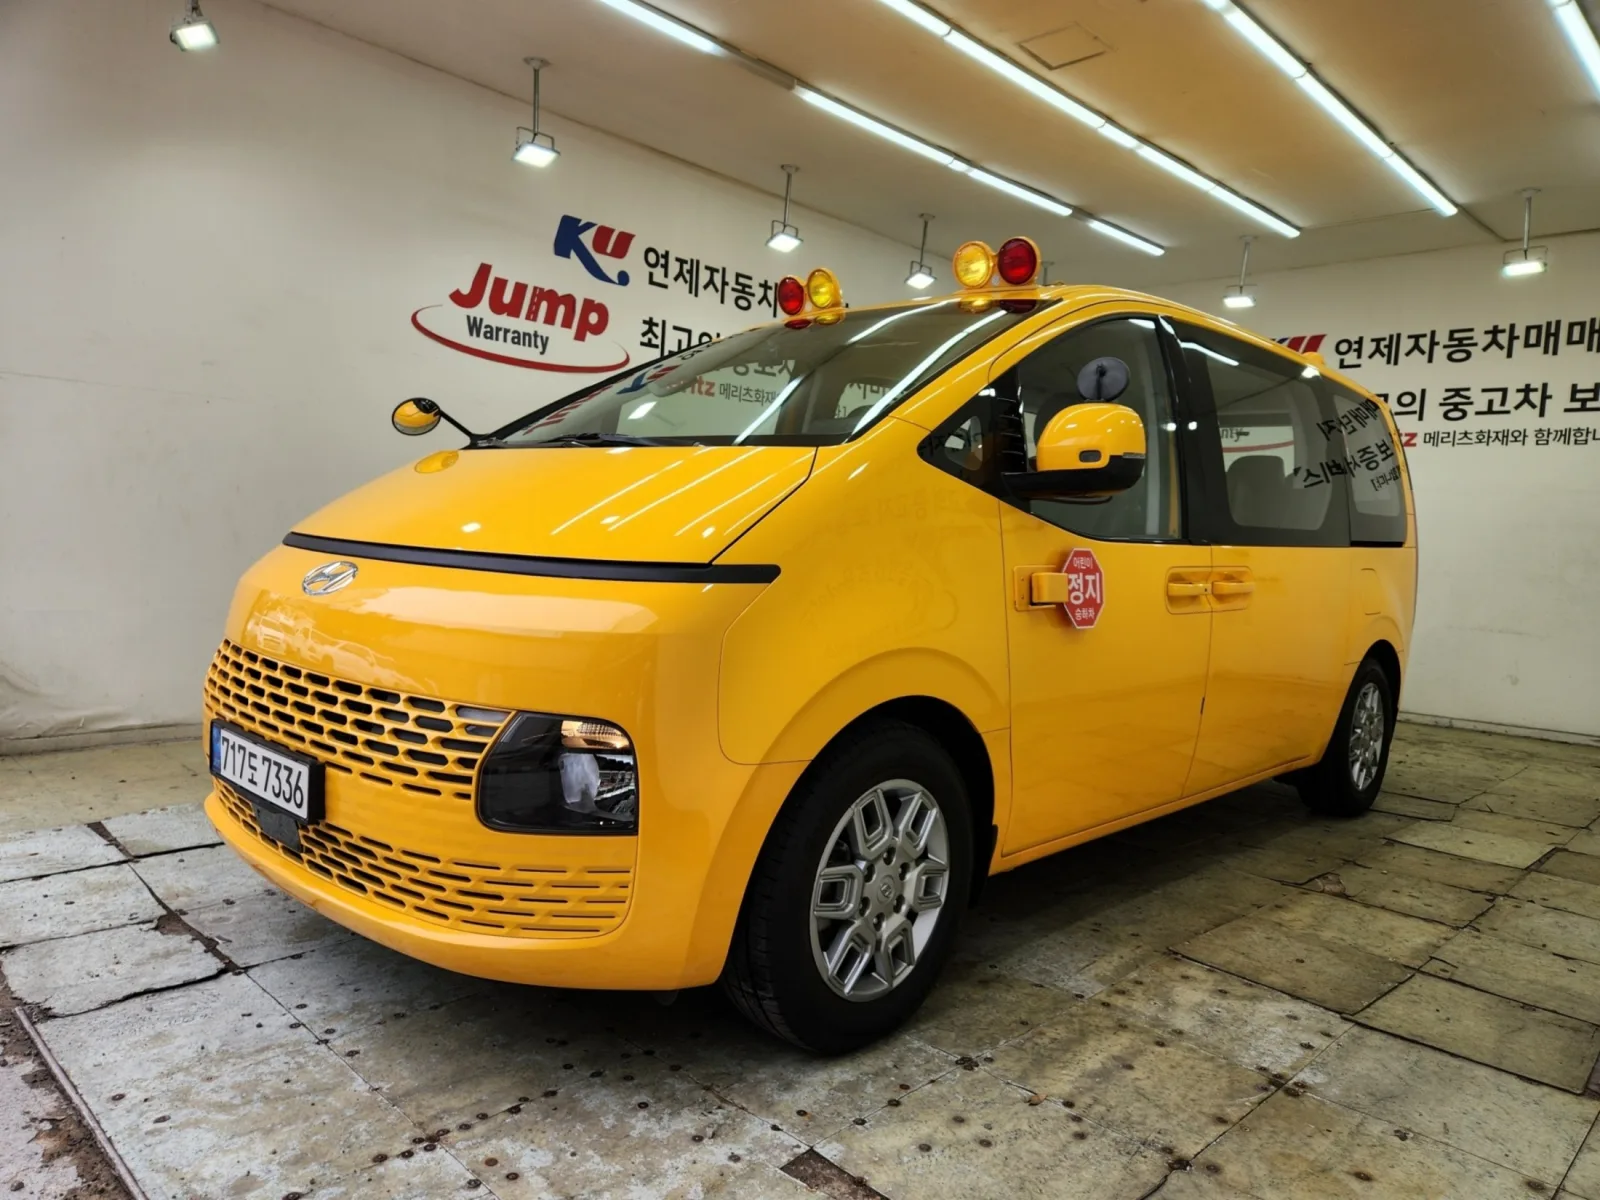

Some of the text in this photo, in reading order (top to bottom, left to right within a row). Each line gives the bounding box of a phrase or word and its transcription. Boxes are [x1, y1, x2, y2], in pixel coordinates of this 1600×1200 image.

[644, 246, 779, 318] 연제자동차
[449, 262, 610, 342] Jump
[466, 314, 550, 355] Warranty
[719, 382, 776, 407] 메리츠화재
[1438, 382, 1553, 422] 중고차
[1423, 429, 1529, 448] 메리츠화재와
[1073, 557, 1093, 569] 어린이
[1068, 572, 1100, 604] 정지
[1075, 608, 1095, 620] 승하차
